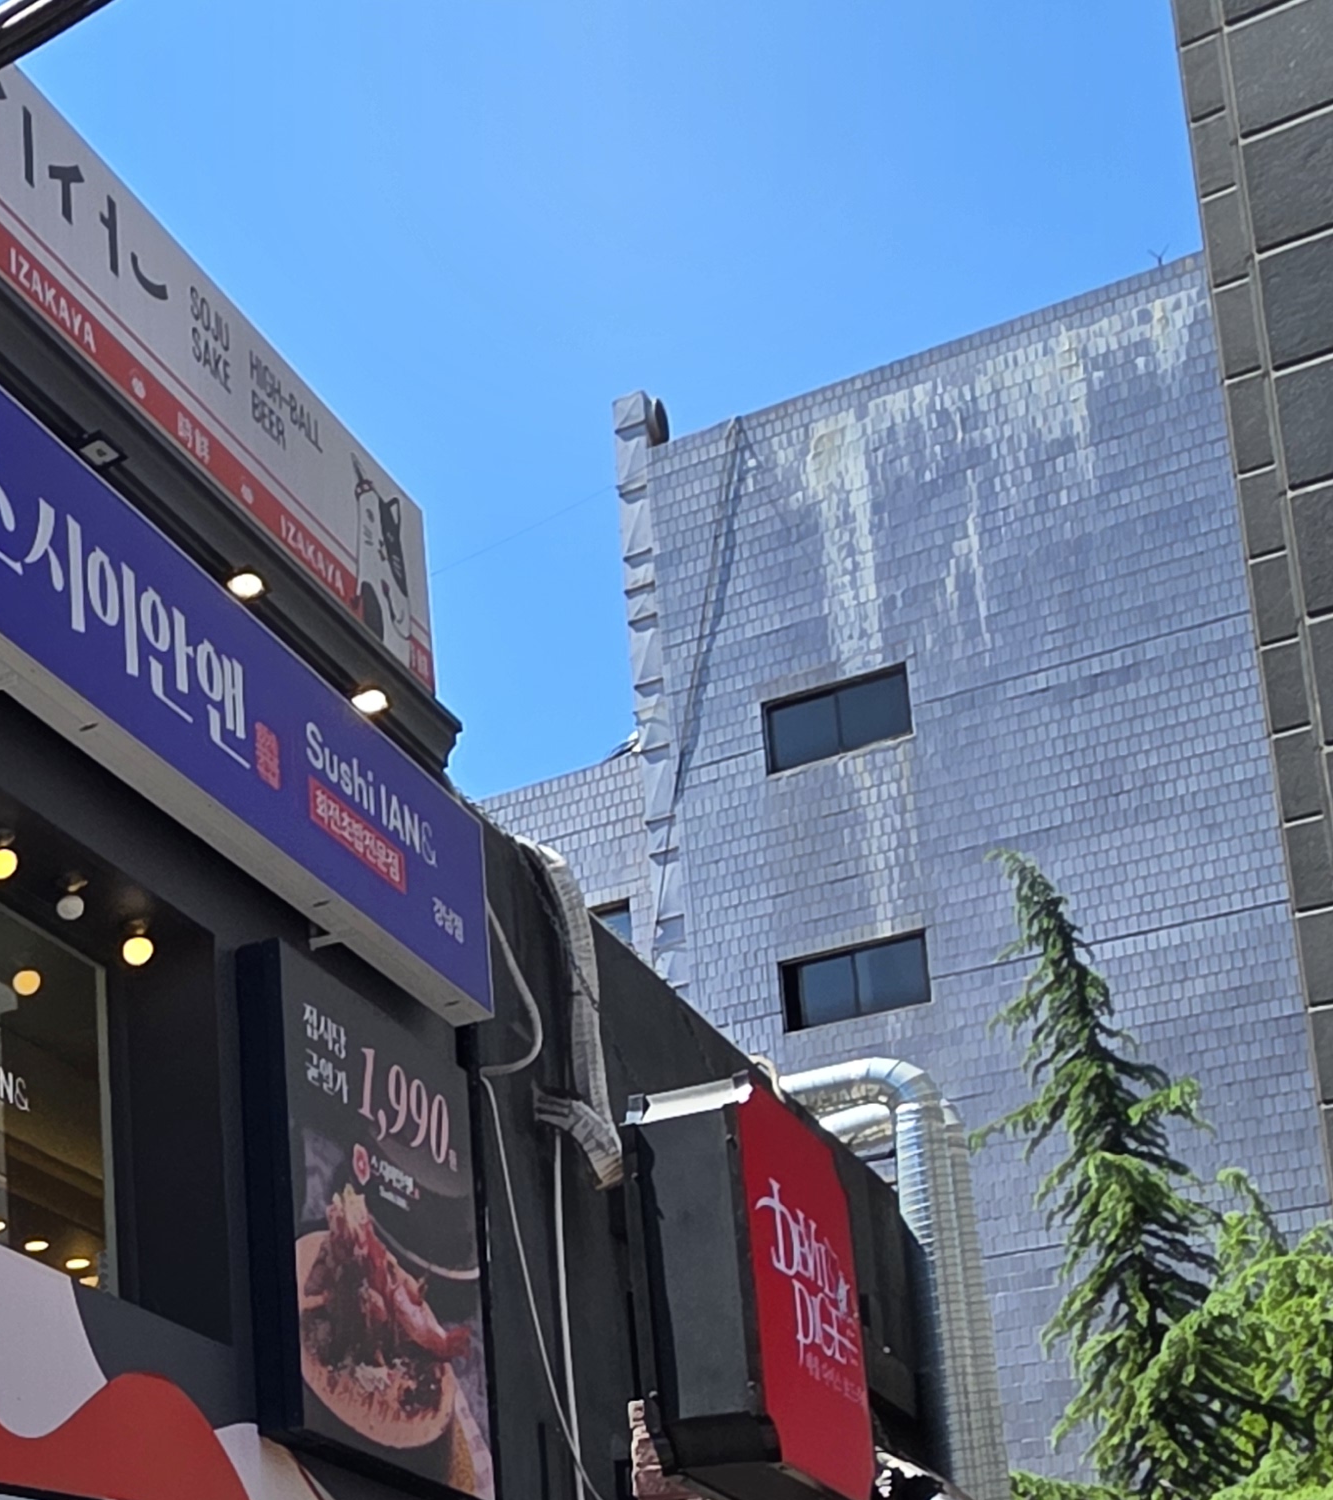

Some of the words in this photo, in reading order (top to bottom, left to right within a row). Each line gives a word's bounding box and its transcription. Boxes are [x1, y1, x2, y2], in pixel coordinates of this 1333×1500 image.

[9, 247, 98, 354] IZAKAYA
[189, 286, 230, 353] SOJU
[249, 350, 323, 454] HIGH-BALL
[191, 327, 232, 394] SAKE
[250, 390, 286, 450] BEER
[279, 515, 347, 597] IZAKAYA
[306, 722, 375, 816] Sushi
